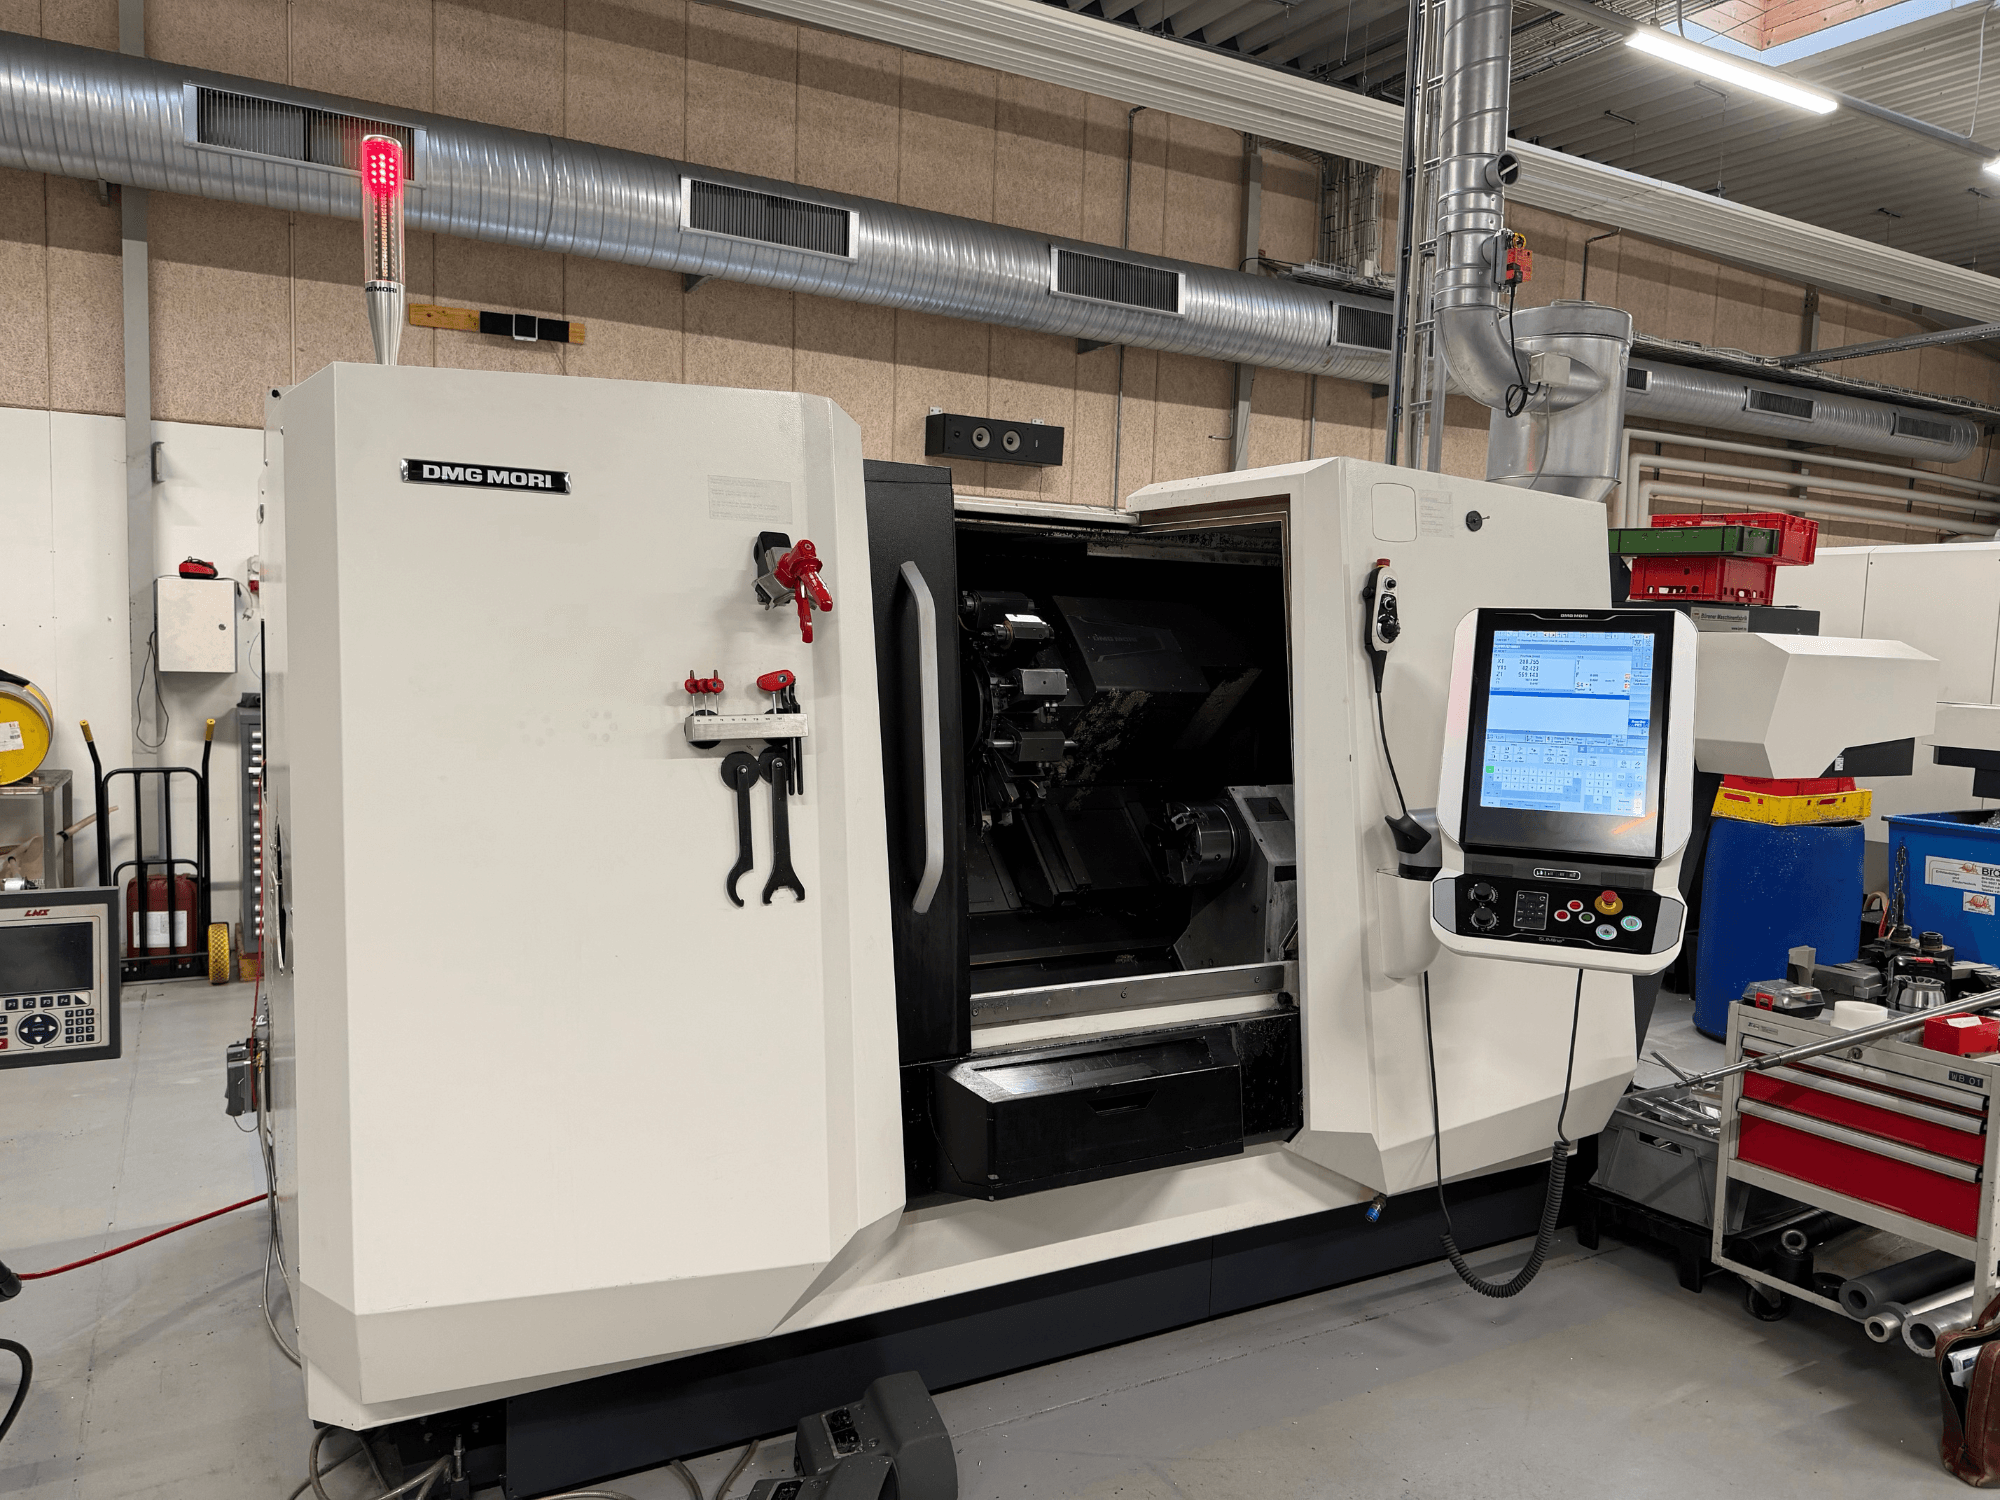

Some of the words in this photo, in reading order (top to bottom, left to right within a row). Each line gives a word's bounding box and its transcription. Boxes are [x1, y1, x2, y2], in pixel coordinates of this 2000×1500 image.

[374, 286, 397, 294] MORI
[422, 464, 483, 483] DMG
[487, 470, 553, 489] MORI
[1951, 1073, 1965, 1082] WB
